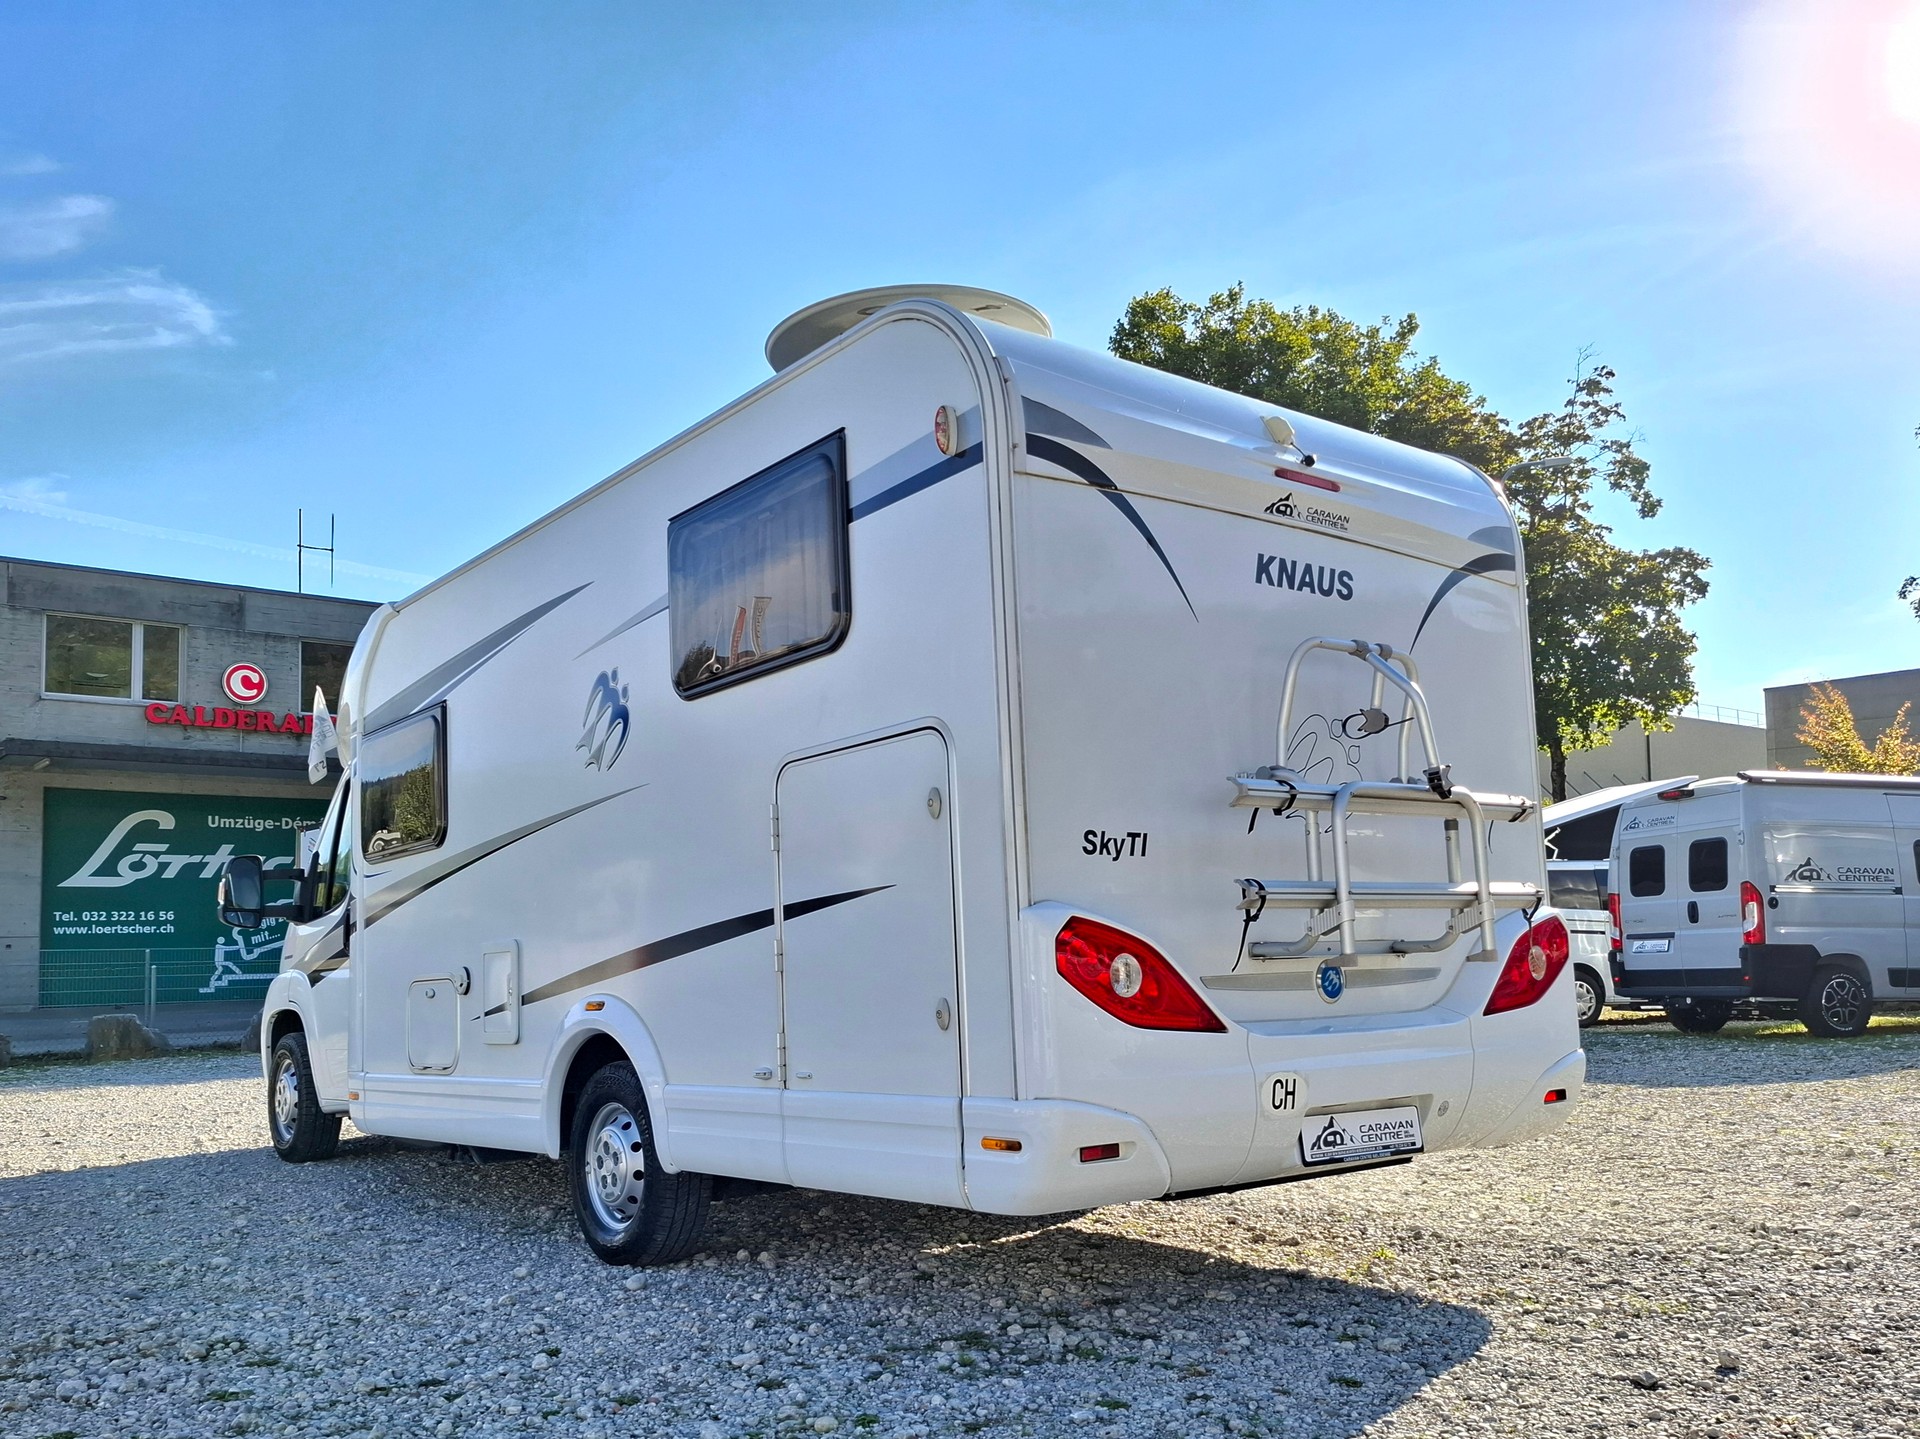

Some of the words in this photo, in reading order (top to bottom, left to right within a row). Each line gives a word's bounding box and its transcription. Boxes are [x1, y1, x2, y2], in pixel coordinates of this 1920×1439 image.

[1305, 514, 1339, 529] CENTRE
[1306, 507, 1350, 524] CARAVAN
[1255, 552, 1354, 602] KNAUS
[1646, 815, 1676, 823] CARAVAN
[1837, 867, 1894, 875] CARAVAN
[1838, 874, 1883, 882] CENTRE
[53, 911, 78, 921] Tel.
[82, 911, 107, 921] 032
[110, 911, 135, 921] 322
[139, 911, 155, 920] 16
[158, 911, 175, 920] 56
[53, 923, 175, 935] www.loertscher.ch
[1271, 1078, 1297, 1110] CH
[1359, 1119, 1414, 1134] CARAVAN
[1360, 1130, 1404, 1144] CENTRE
